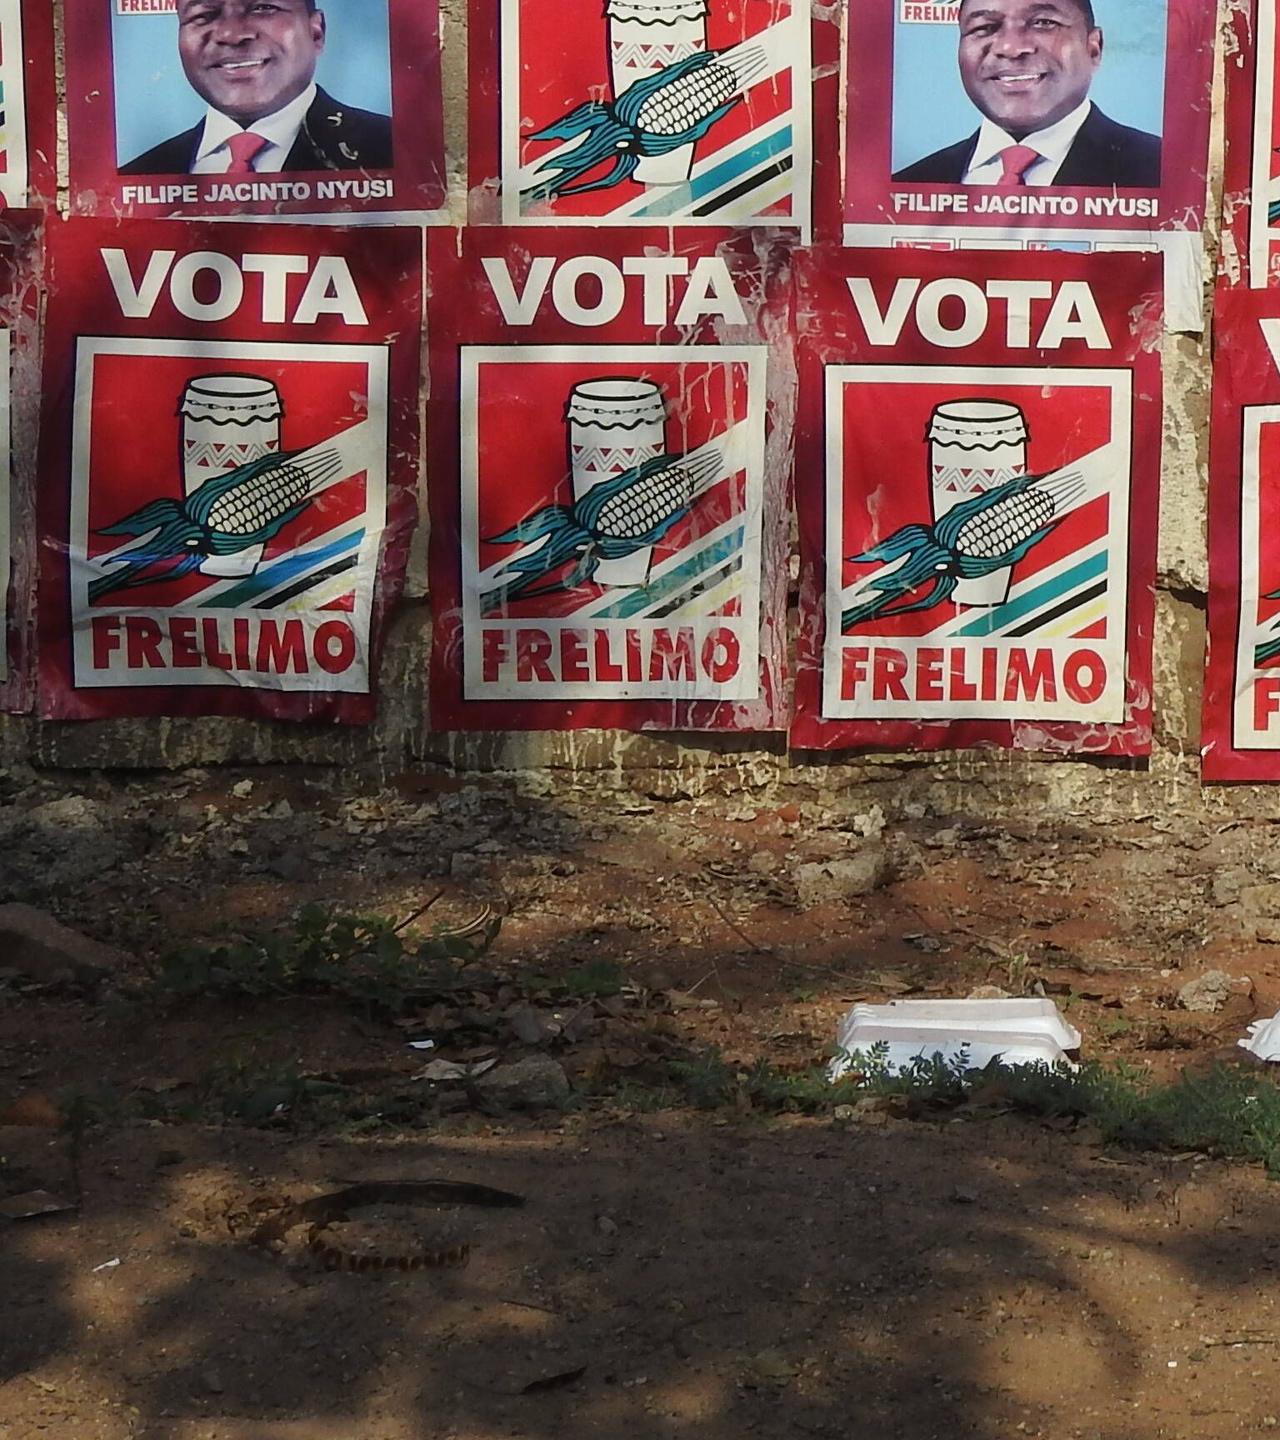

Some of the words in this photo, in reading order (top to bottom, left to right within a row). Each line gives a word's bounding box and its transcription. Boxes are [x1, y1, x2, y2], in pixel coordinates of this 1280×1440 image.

[122, 183, 198, 205] FILIPE
[203, 181, 310, 204] JACINTO
[316, 179, 393, 200] NYUSI
[895, 193, 968, 213] FILIPE
[974, 194, 1079, 216] JACINTO
[1084, 198, 1159, 218] NYUSI
[100, 248, 371, 326] VOTA
[481, 257, 747, 328] VOTA
[847, 277, 1112, 350] VOTA
[92, 615, 355, 675] FRELIMO
[482, 626, 740, 684] FRELIMO
[841, 646, 1106, 704] FRELIMO
